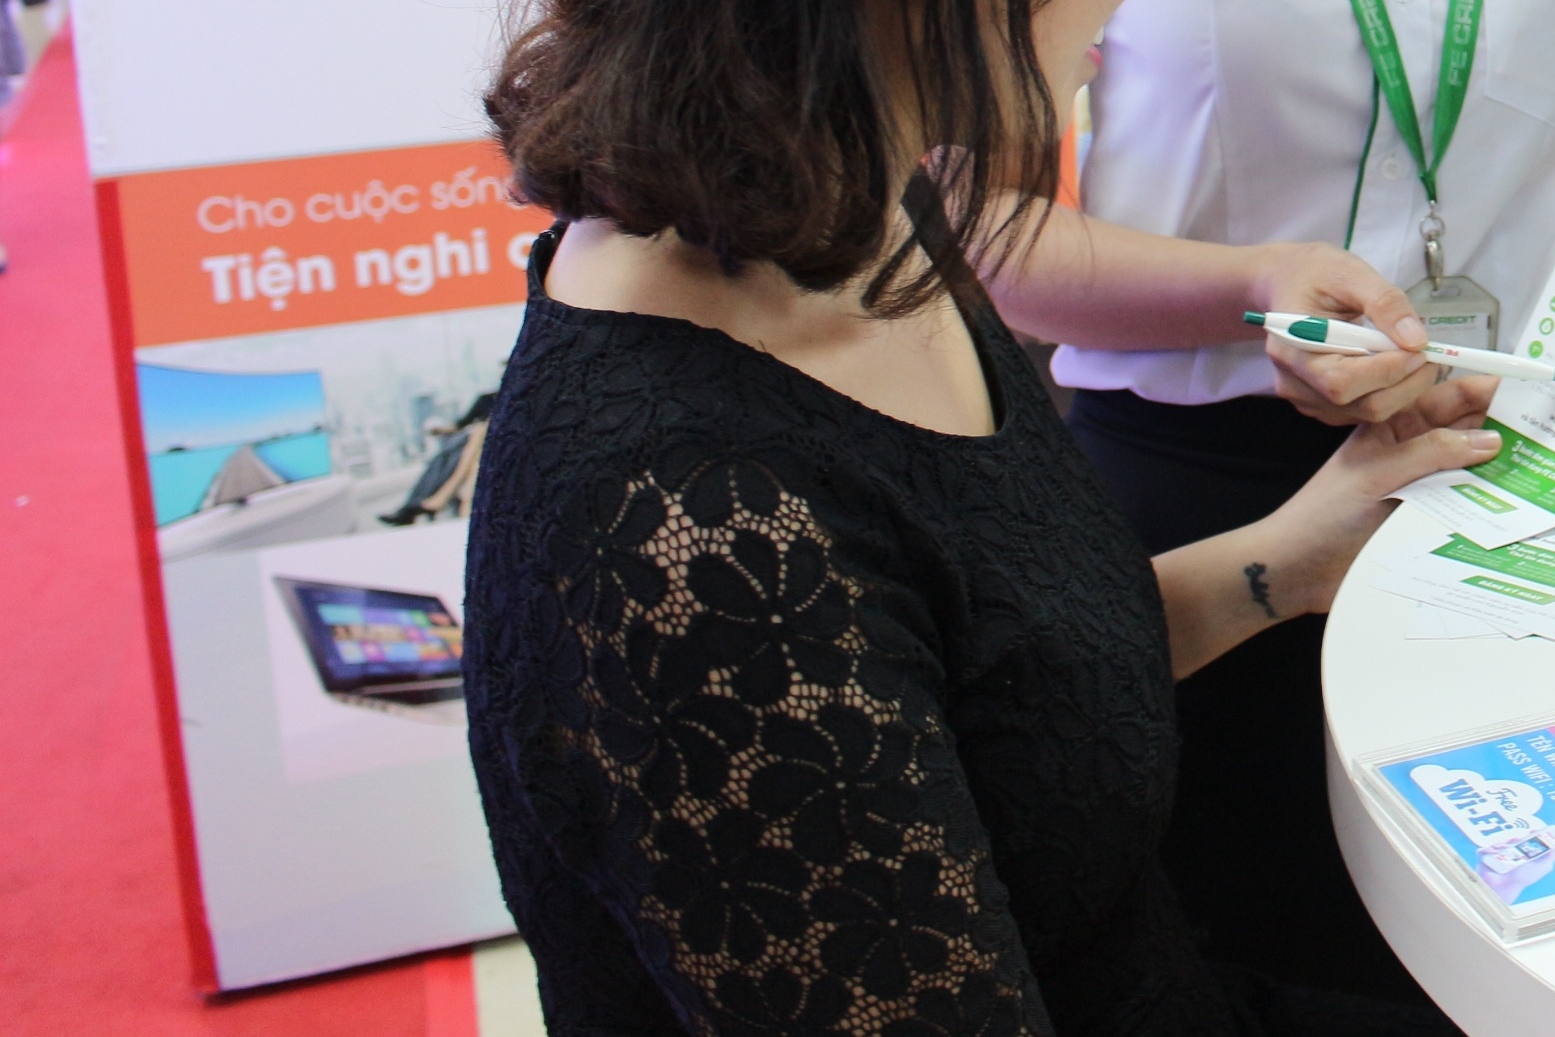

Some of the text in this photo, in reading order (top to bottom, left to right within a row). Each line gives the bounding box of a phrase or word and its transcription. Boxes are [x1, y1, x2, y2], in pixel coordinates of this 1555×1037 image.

[198, 166, 530, 236] Cho cuộc sốn
[201, 227, 491, 311] Tiện nghi
[1496, 742, 1532, 768] PASS
[1525, 733, 1551, 755] TÊN
[1439, 777, 1516, 838] Wi-Fi
[1486, 786, 1519, 813] Free
